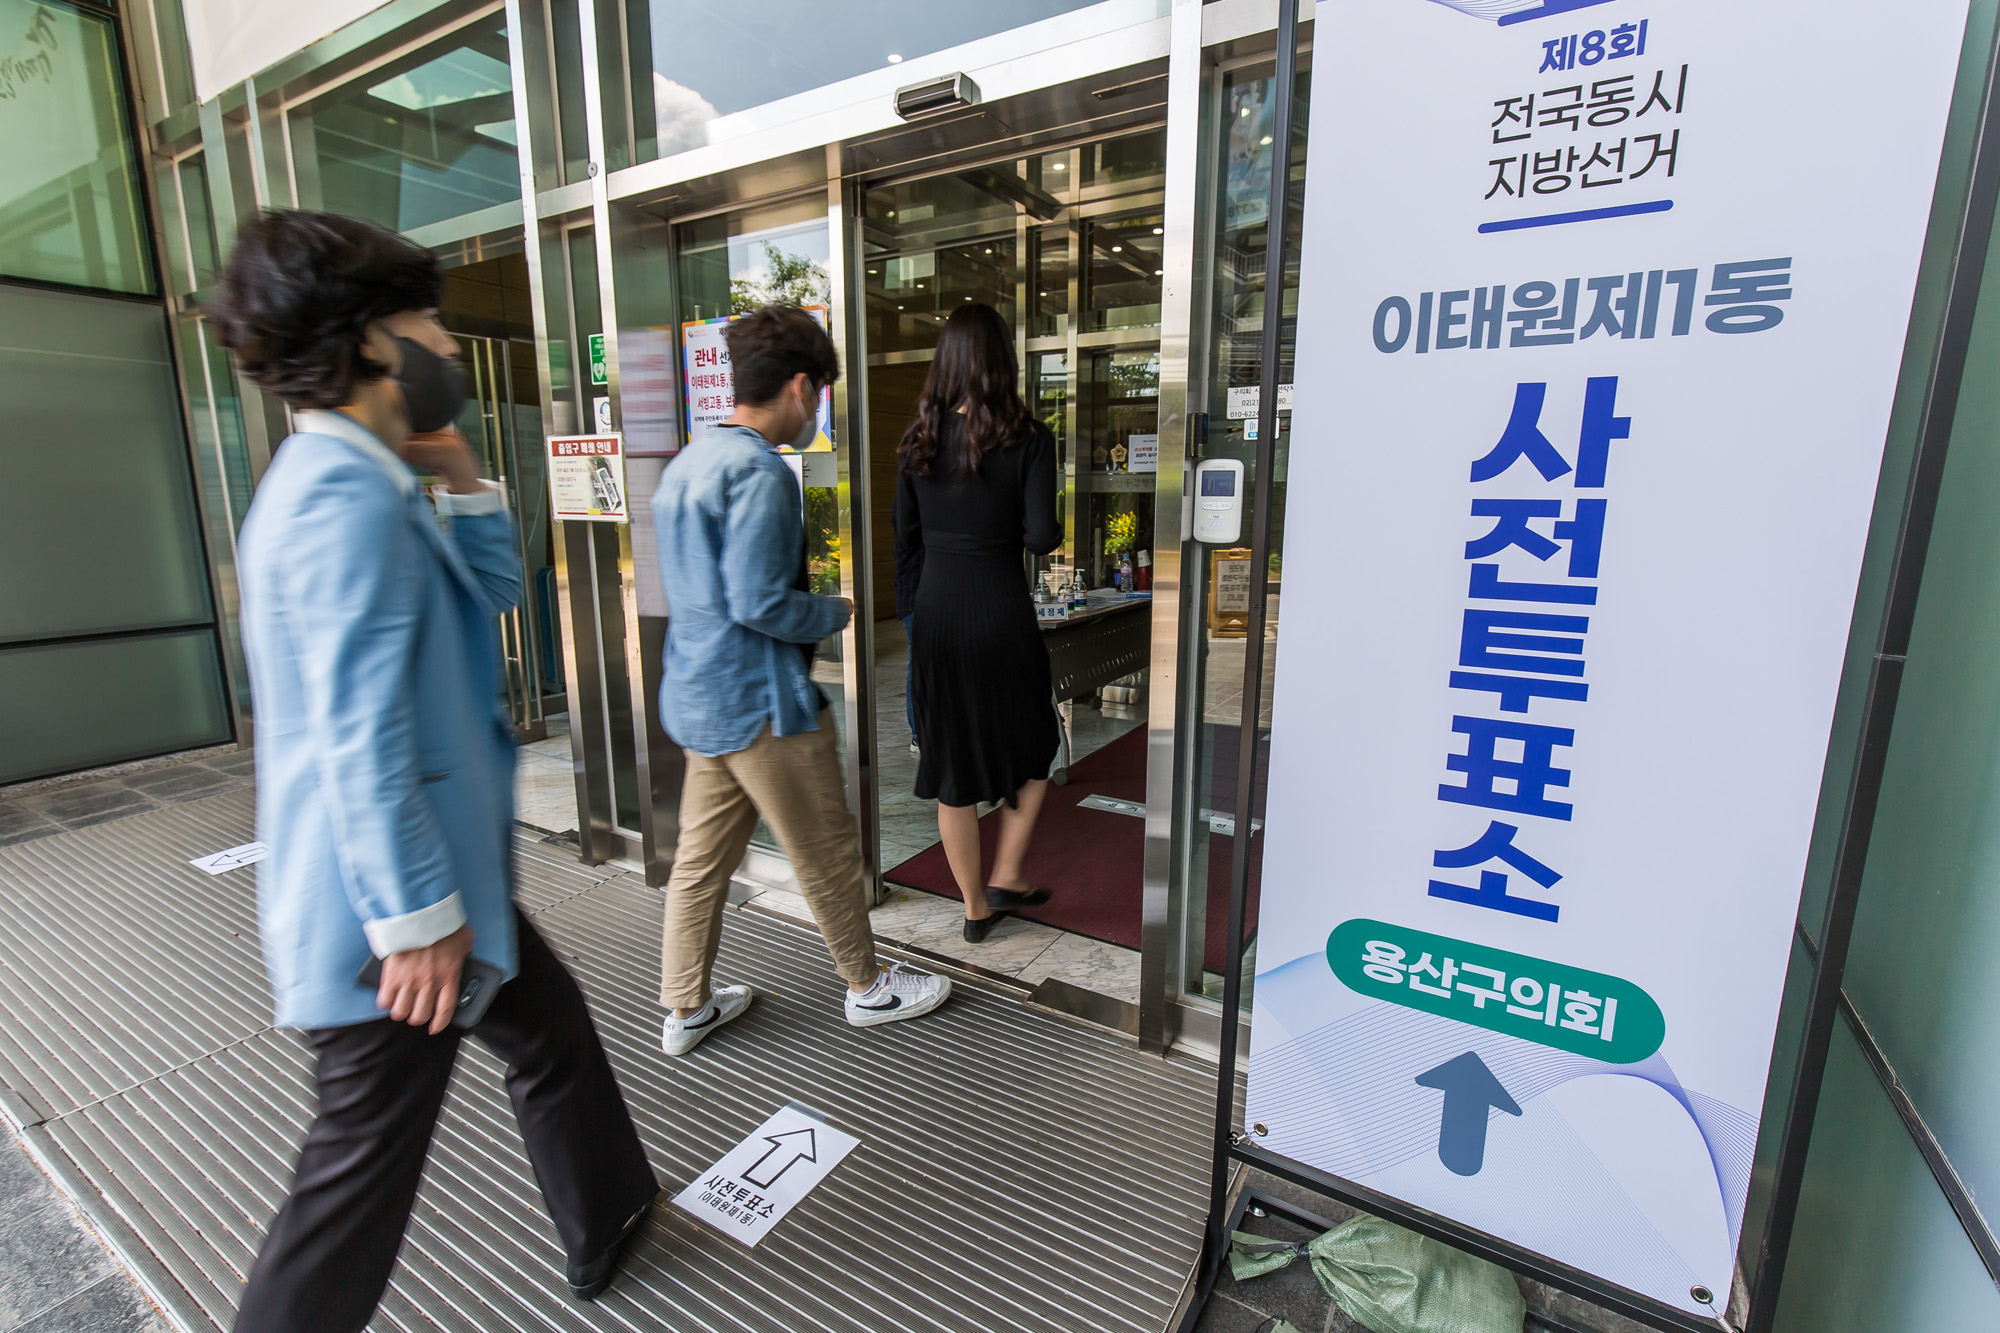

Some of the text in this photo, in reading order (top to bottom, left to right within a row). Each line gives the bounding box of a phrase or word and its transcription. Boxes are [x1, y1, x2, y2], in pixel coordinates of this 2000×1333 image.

[1538, 18, 1649, 74] 제8회
[1491, 63, 1689, 145] 전국동시
[1484, 128, 1681, 201] 지방선거
[1372, 257, 1793, 355] 이태원제1동
[691, 373, 729, 390] 이태원제1동,
[694, 347, 718, 368] 관내
[1241, 399, 1259, 407] 02)21
[1427, 376, 1632, 923] 사전투표소
[1361, 939, 1618, 1042] 용산구의회
[697, 1190, 758, 1227] (이태원제1동)
[703, 1174, 776, 1219] 사전투표소
